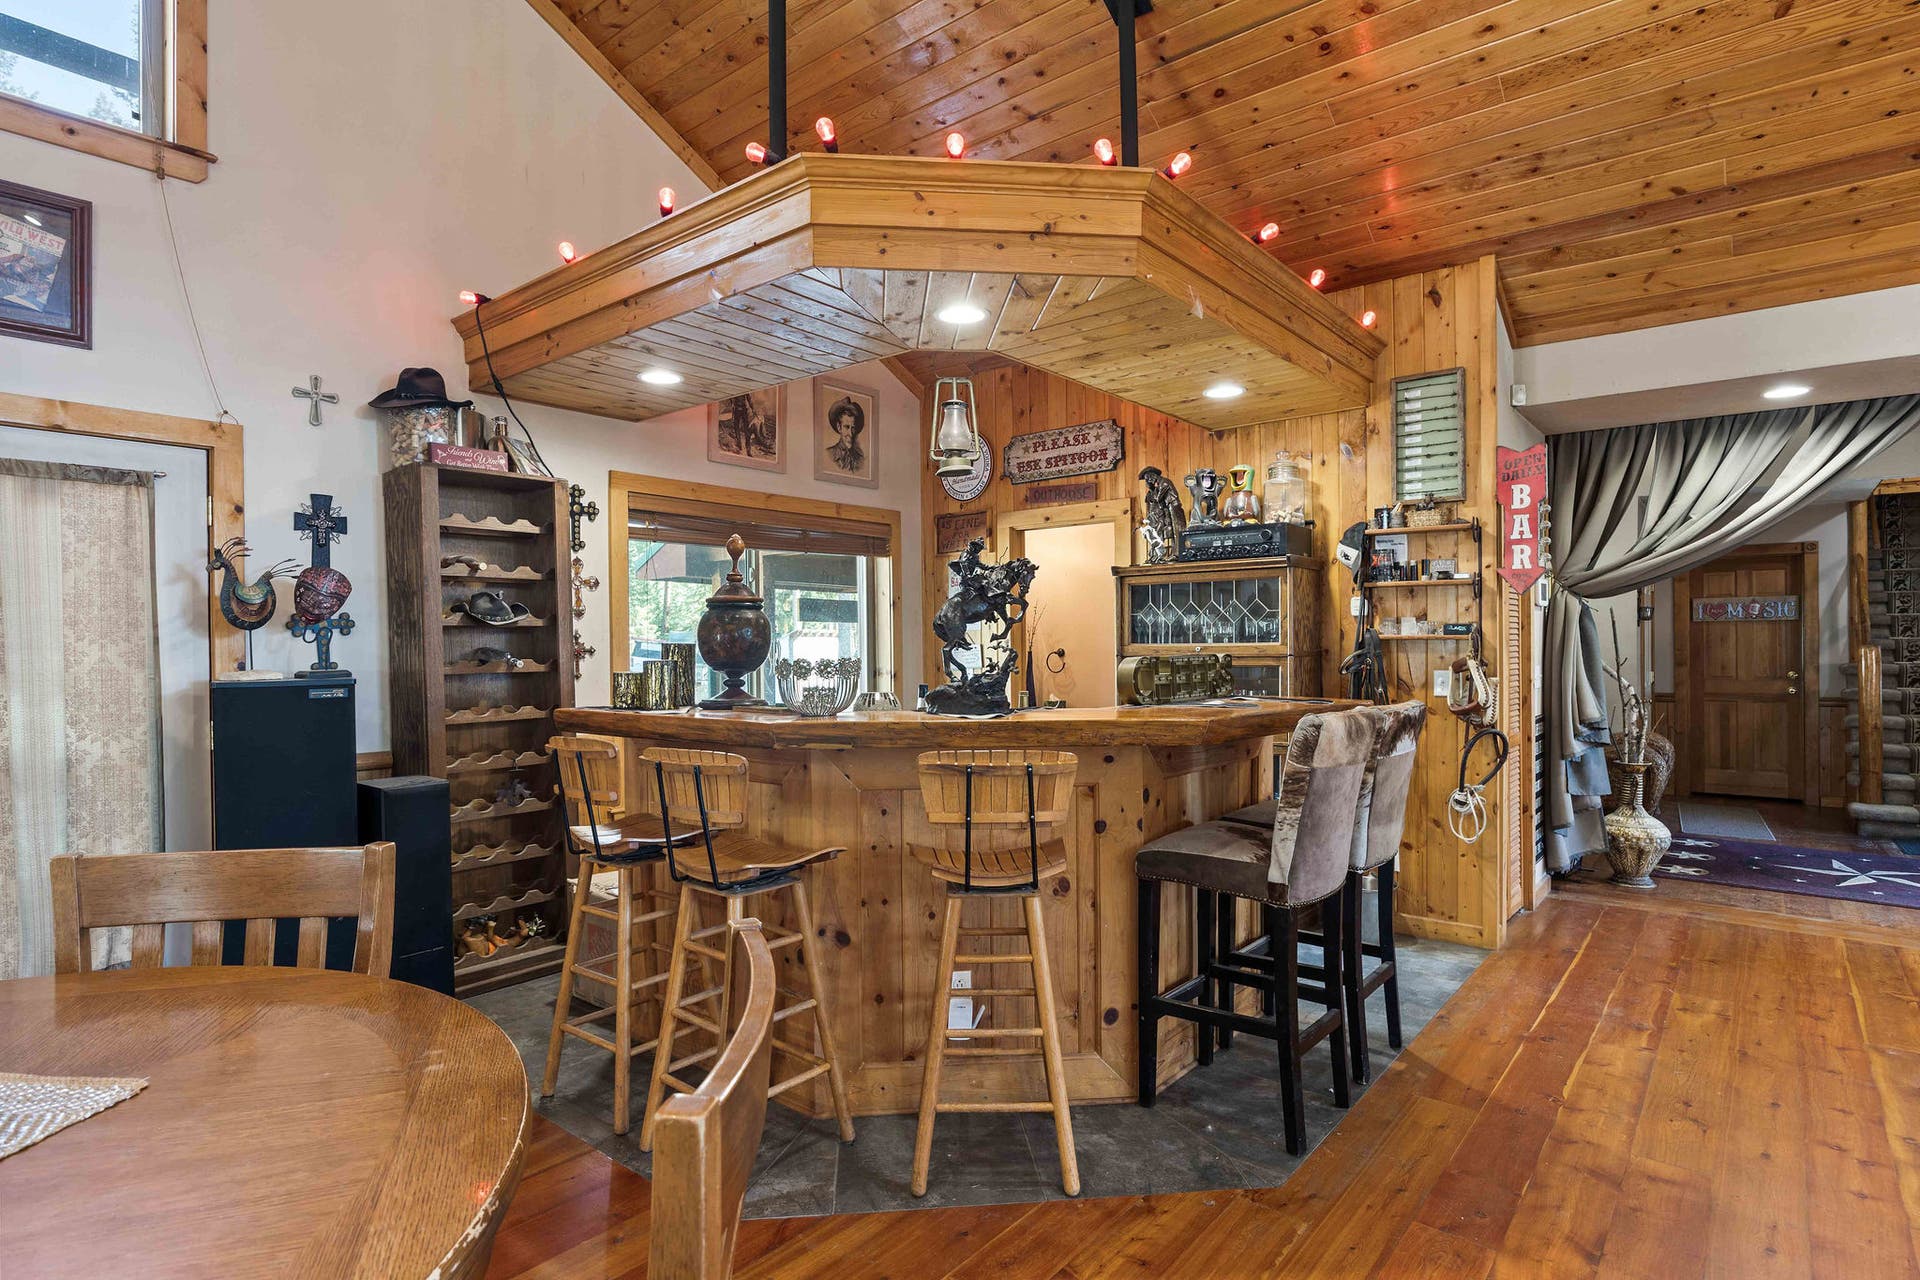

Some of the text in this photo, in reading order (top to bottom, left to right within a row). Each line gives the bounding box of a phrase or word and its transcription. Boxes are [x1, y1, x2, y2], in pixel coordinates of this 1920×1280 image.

[28, 231, 64, 250] WEST
[1032, 432, 1091, 453] PLEASE
[473, 452, 498, 465] Wine
[1016, 448, 1109, 474] USE SPITOON
[1503, 453, 1543, 470] OPEN
[1502, 464, 1543, 482] DAILY
[1034, 485, 1091, 501] OUTHOUSE
[1510, 484, 1533, 570] BAR
[1697, 603, 1704, 620] I
[1727, 600, 1796, 619] MSIC
